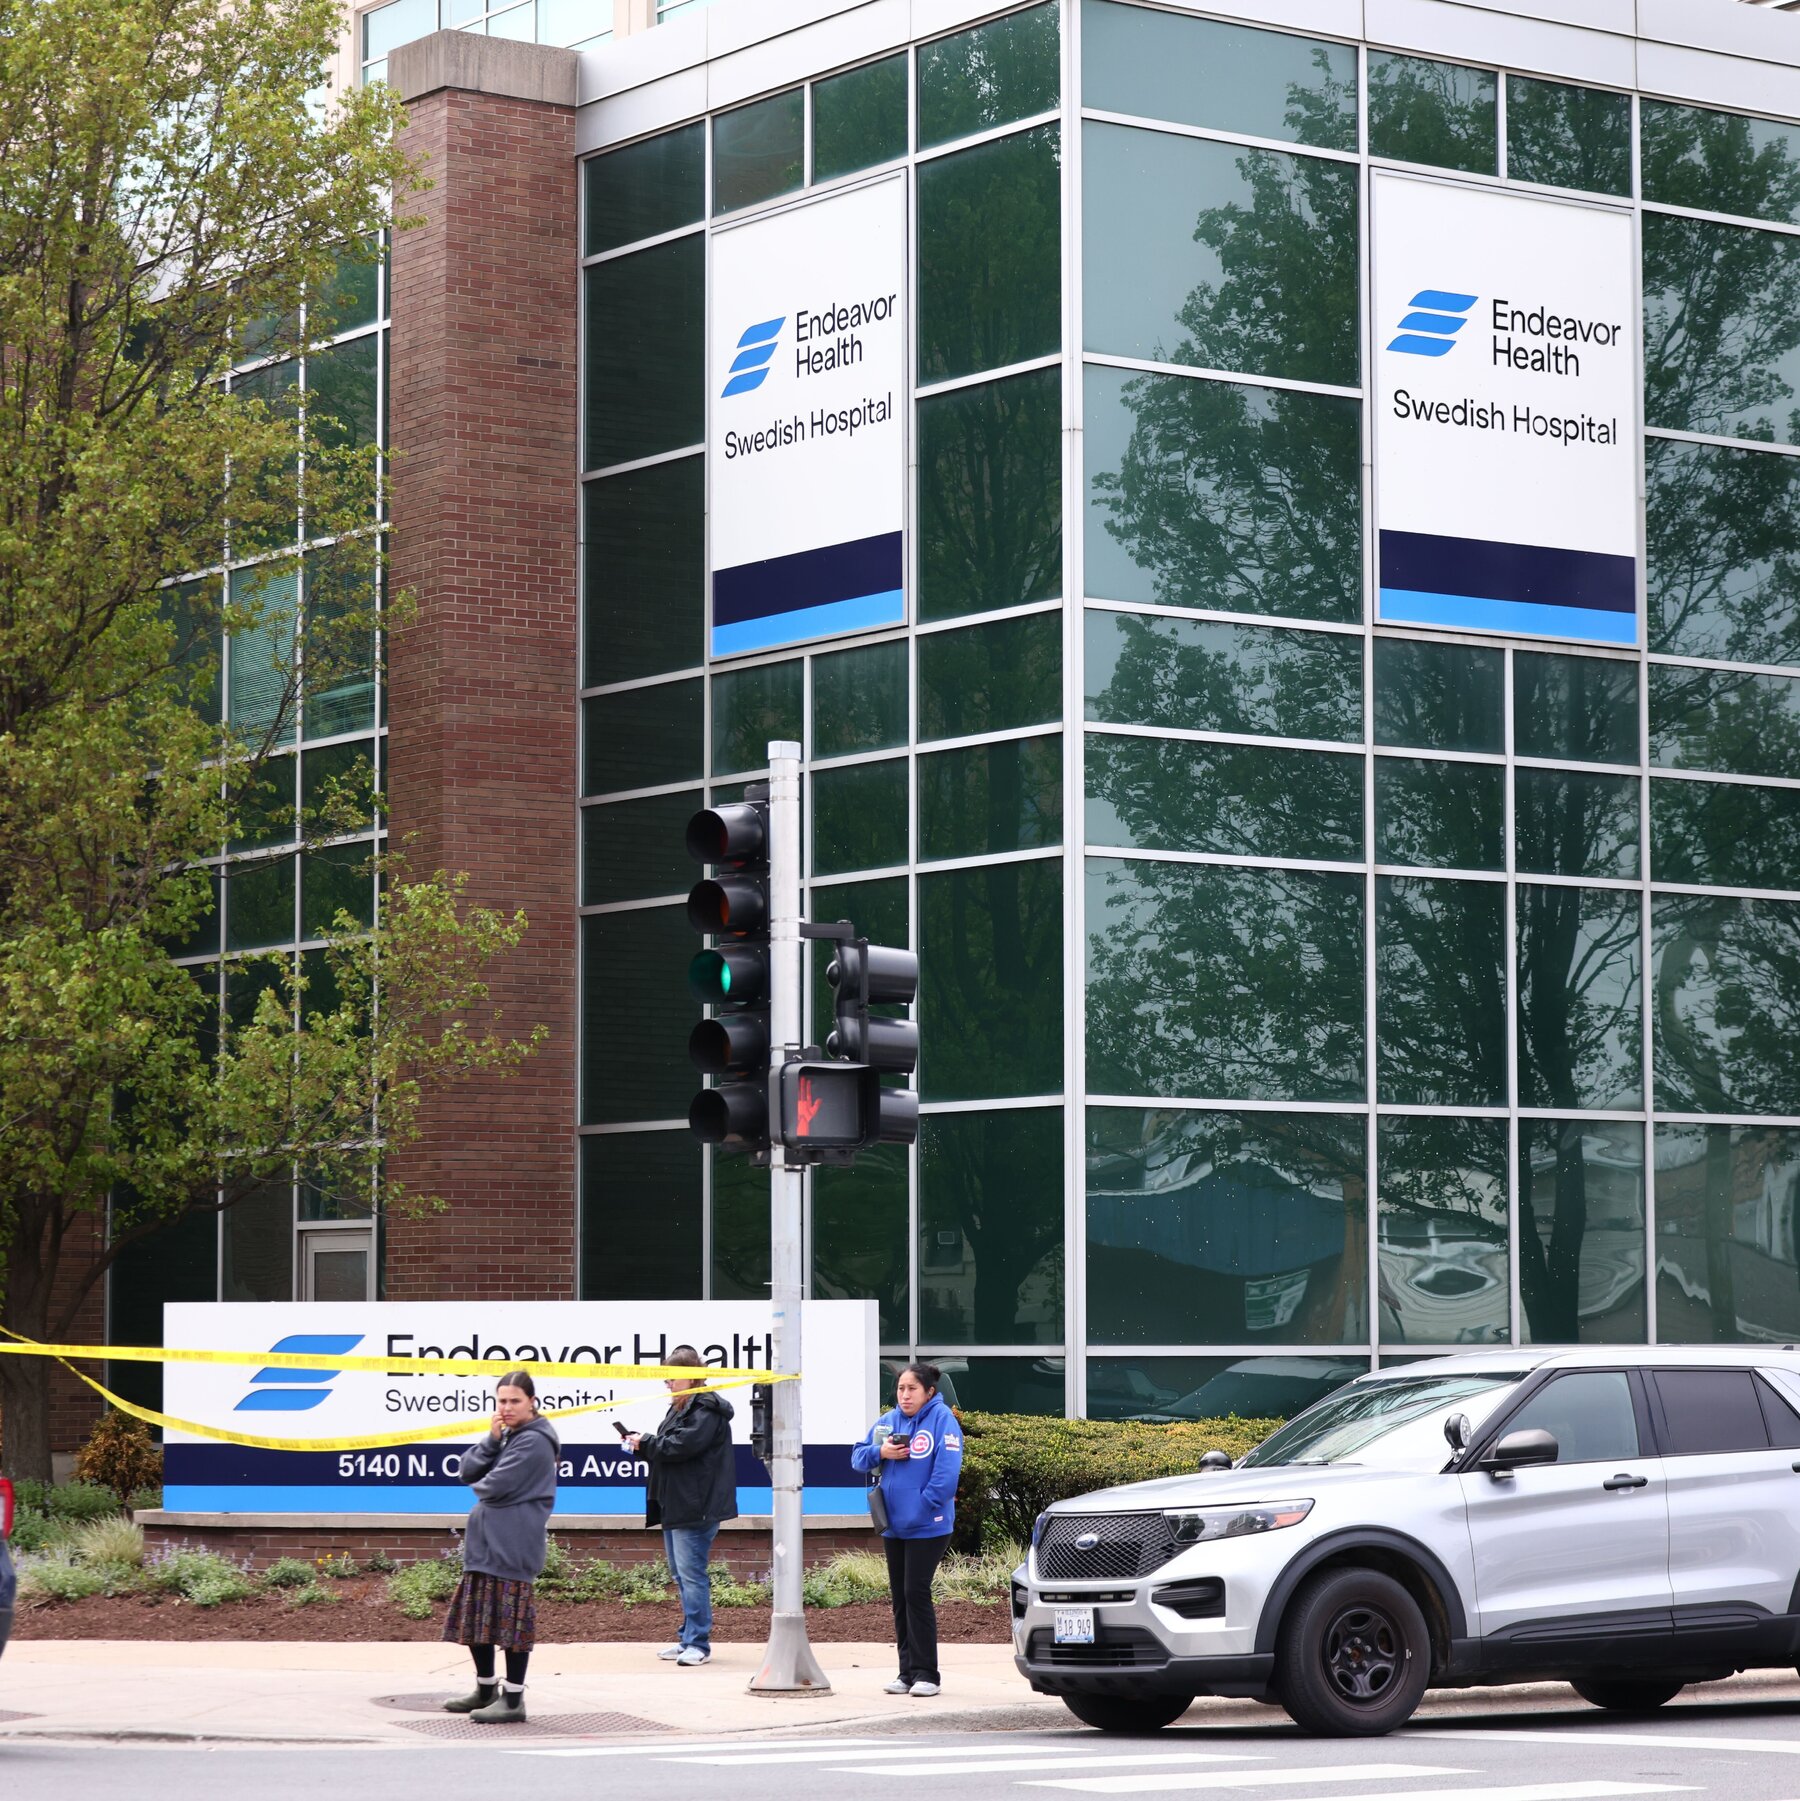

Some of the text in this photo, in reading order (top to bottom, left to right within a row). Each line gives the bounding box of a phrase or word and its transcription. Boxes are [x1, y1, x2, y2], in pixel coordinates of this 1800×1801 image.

[797, 294, 897, 342] Endeavor
[1492, 299, 1622, 347] Endeavor
[796, 334, 863, 379] Health
[1492, 335, 1580, 377] Health
[724, 392, 892, 460] Swedish Hospital
[1393, 389, 1617, 447] Swedish Hospital
[386, 1390, 497, 1412] Swedish
[338, 1454, 400, 1477] 5140
[408, 1454, 434, 1477] N.
[581, 1455, 649, 1478] Aven
[1077, 1619, 1091, 1636] 949
